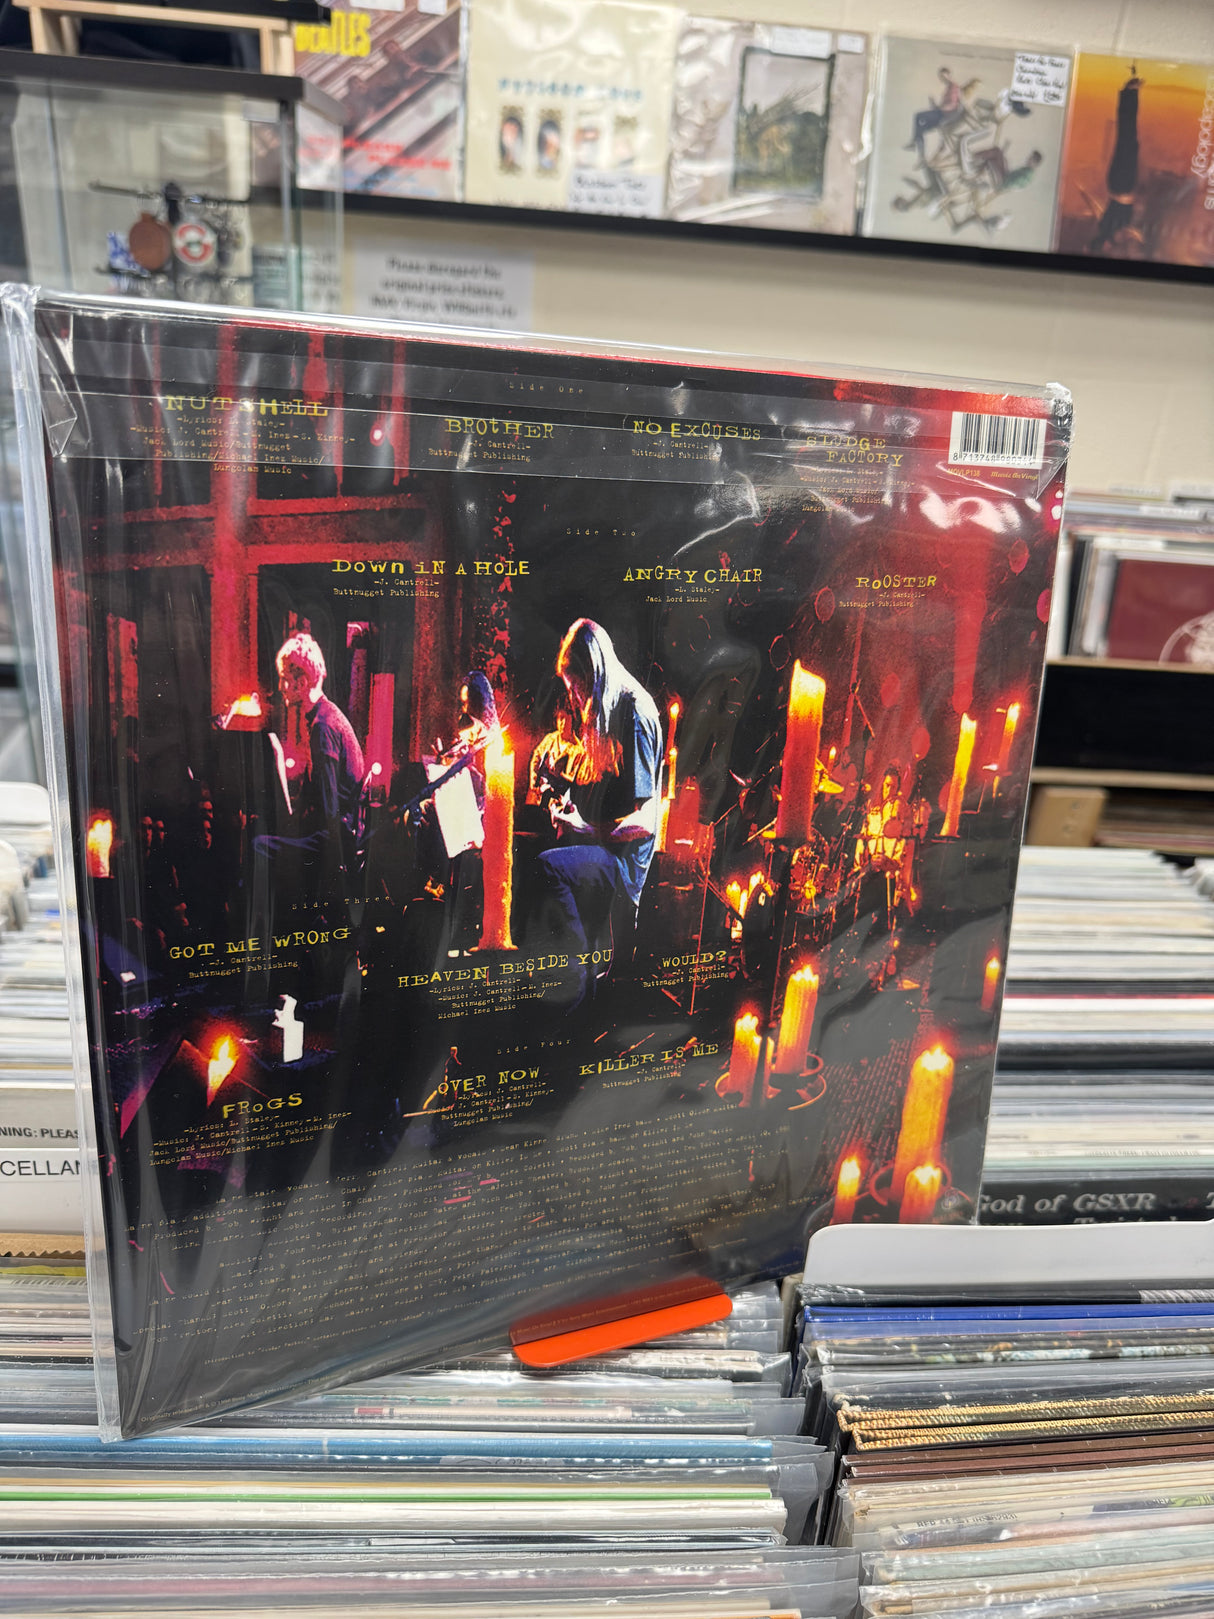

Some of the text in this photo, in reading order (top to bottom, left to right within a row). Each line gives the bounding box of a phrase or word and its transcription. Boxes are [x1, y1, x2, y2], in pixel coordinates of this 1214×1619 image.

[165, 394, 328, 416] NUTSHELL
[633, 420, 761, 441] NO EXCUSES
[806, 435, 886, 451] SLUDGE
[483, 452, 531, 462] Publishing
[826, 450, 904, 467] FACTORY
[953, 453, 958, 461] 8
[566, 528, 599, 536] Side
[455, 563, 467, 575] A
[473, 561, 530, 576] HOLE
[623, 566, 762, 583] ANGRY CHAIR
[856, 575, 936, 589] ROOSTER
[333, 588, 439, 598] Buttnugget Publishing
[292, 896, 391, 910] Side Three
[170, 928, 351, 959] GOT ME WRONG
[662, 950, 727, 968] WOULD?
[189, 960, 299, 979] Buttnugget Publishing
[398, 949, 613, 988] HEAVEN BESIDE YOU
[579, 1043, 719, 1076] KILLER IS ME
[438, 1066, 540, 1095] OVER NOW
[979, 1191, 1158, 1214] God of GSXR
